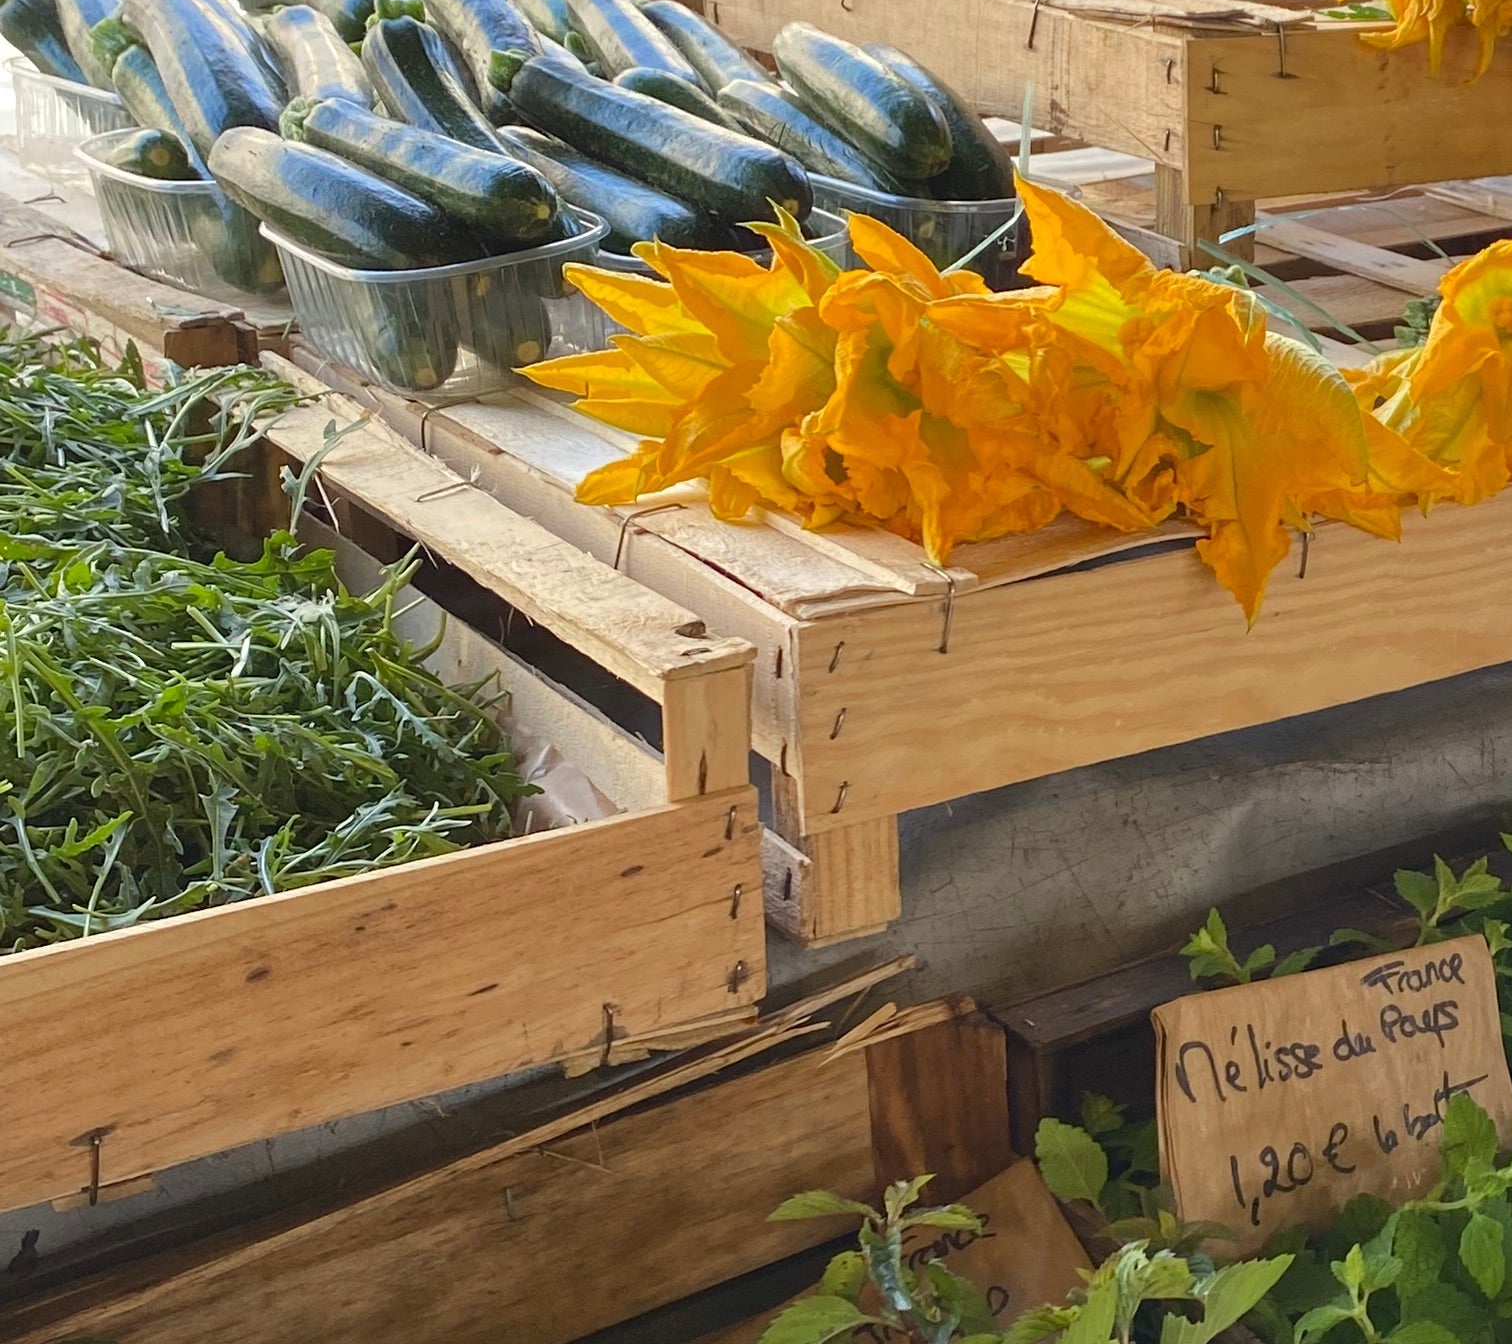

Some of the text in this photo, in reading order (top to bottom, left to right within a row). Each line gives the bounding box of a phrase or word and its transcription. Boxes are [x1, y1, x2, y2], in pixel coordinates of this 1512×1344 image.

[1361, 953, 1466, 994] France
[1175, 1024, 1324, 1103] Mélisse
[1332, 1019, 1377, 1062] du
